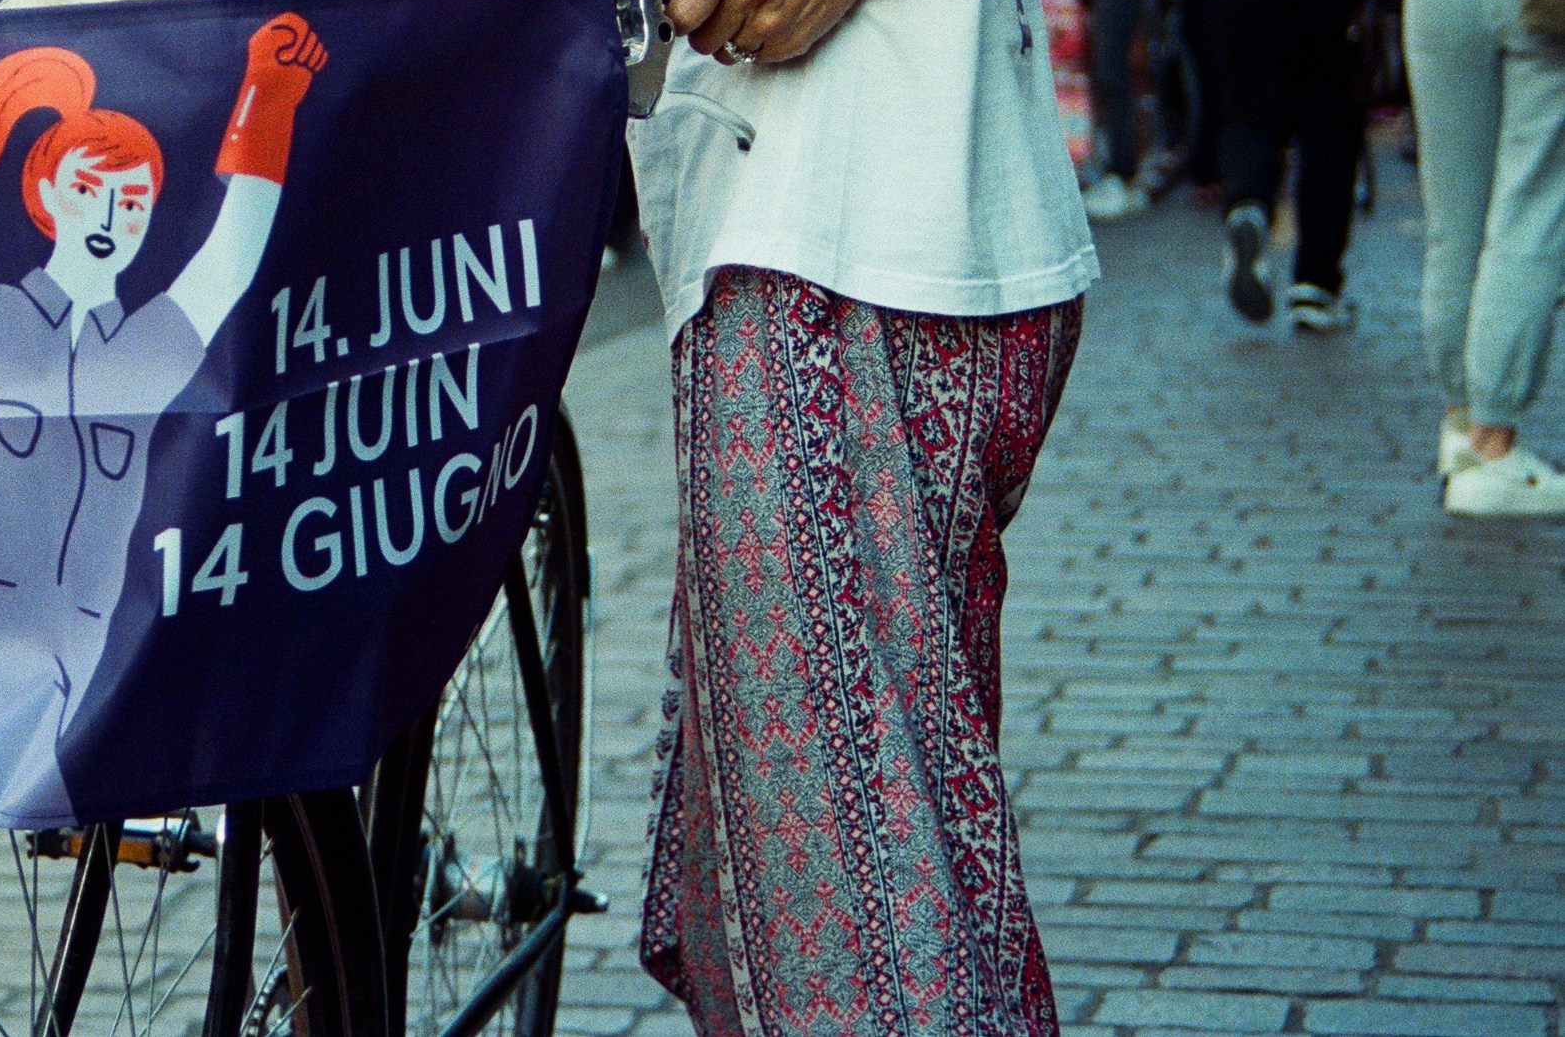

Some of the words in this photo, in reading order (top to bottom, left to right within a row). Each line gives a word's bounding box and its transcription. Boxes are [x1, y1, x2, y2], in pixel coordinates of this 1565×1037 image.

[271, 275, 349, 375] 14.
[370, 218, 541, 349] JUNI
[215, 400, 294, 499] 14
[313, 342, 480, 477] JUIN
[153, 523, 249, 617] 14
[280, 403, 538, 592] GIUGNO
